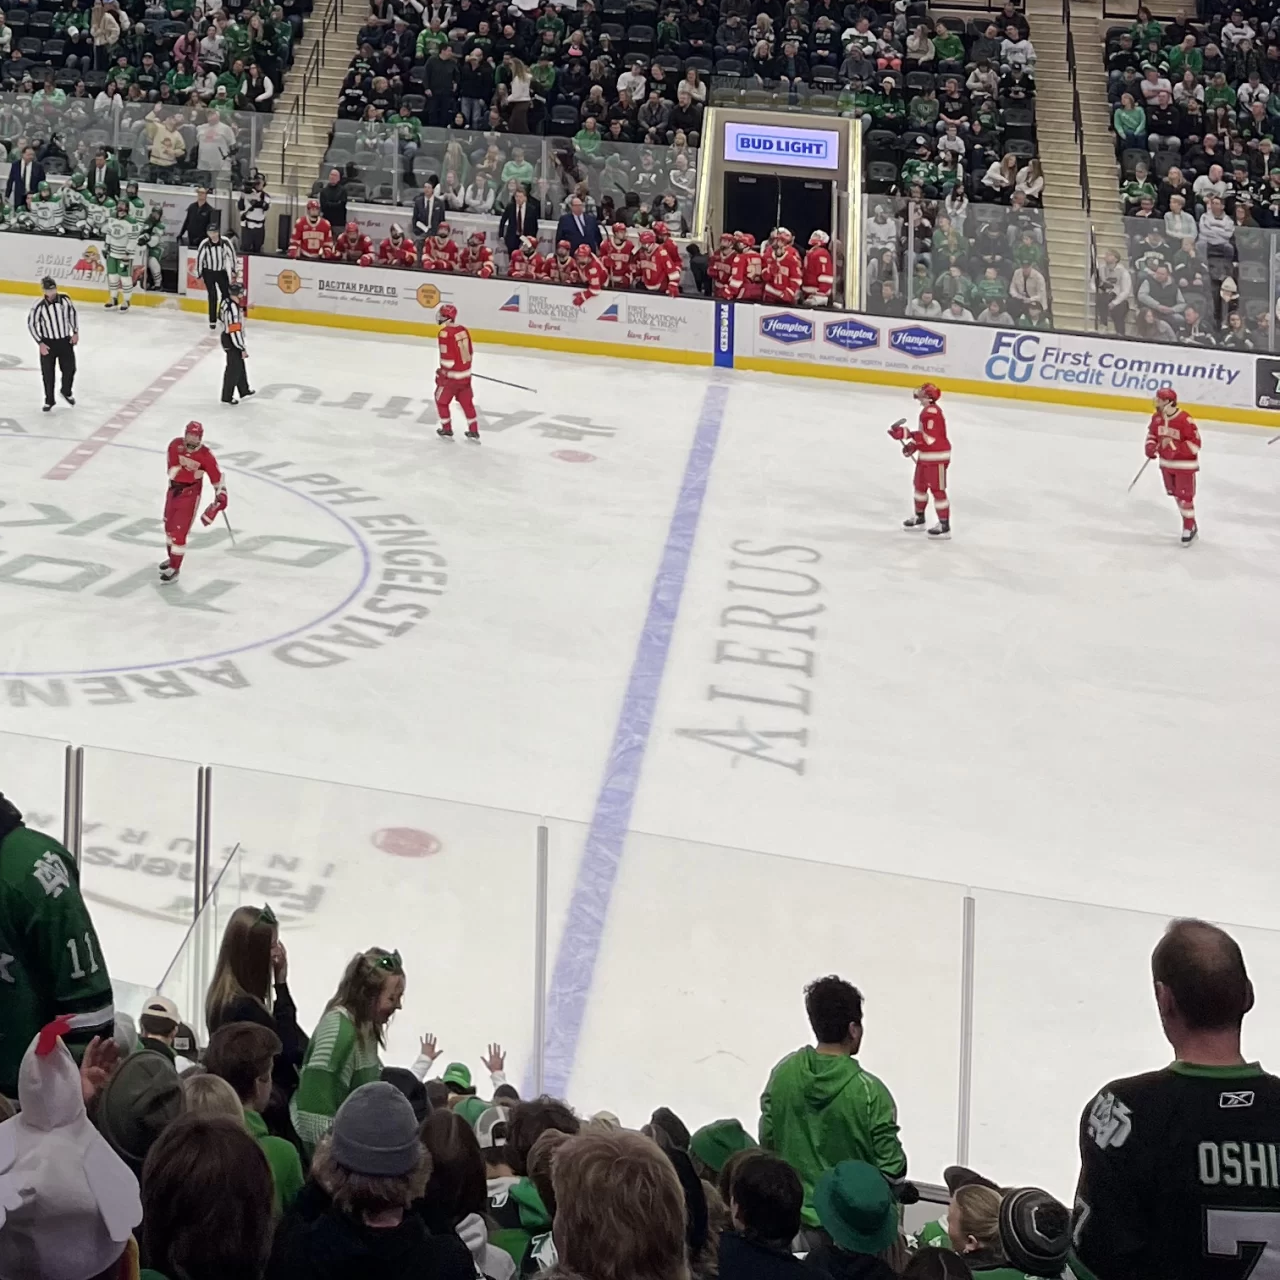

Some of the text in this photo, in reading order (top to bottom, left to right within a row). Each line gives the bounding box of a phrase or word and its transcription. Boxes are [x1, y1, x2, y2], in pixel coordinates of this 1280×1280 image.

[740, 137, 823, 154] BUD LIGHT
[359, 284, 384, 295] PAPER
[763, 319, 812, 333] Hampton
[826, 326, 877, 341] Hampton
[891, 332, 943, 348] Hampton
[991, 331, 1040, 362] FC
[985, 355, 1033, 382] CU
[1039, 365, 1173, 391] Credit Union
[1042, 346, 1240, 385] First Community
[270, 514, 448, 670] ENGELSTAD
[675, 539, 827, 776] ALERUS
[67, 932, 99, 980] 11
